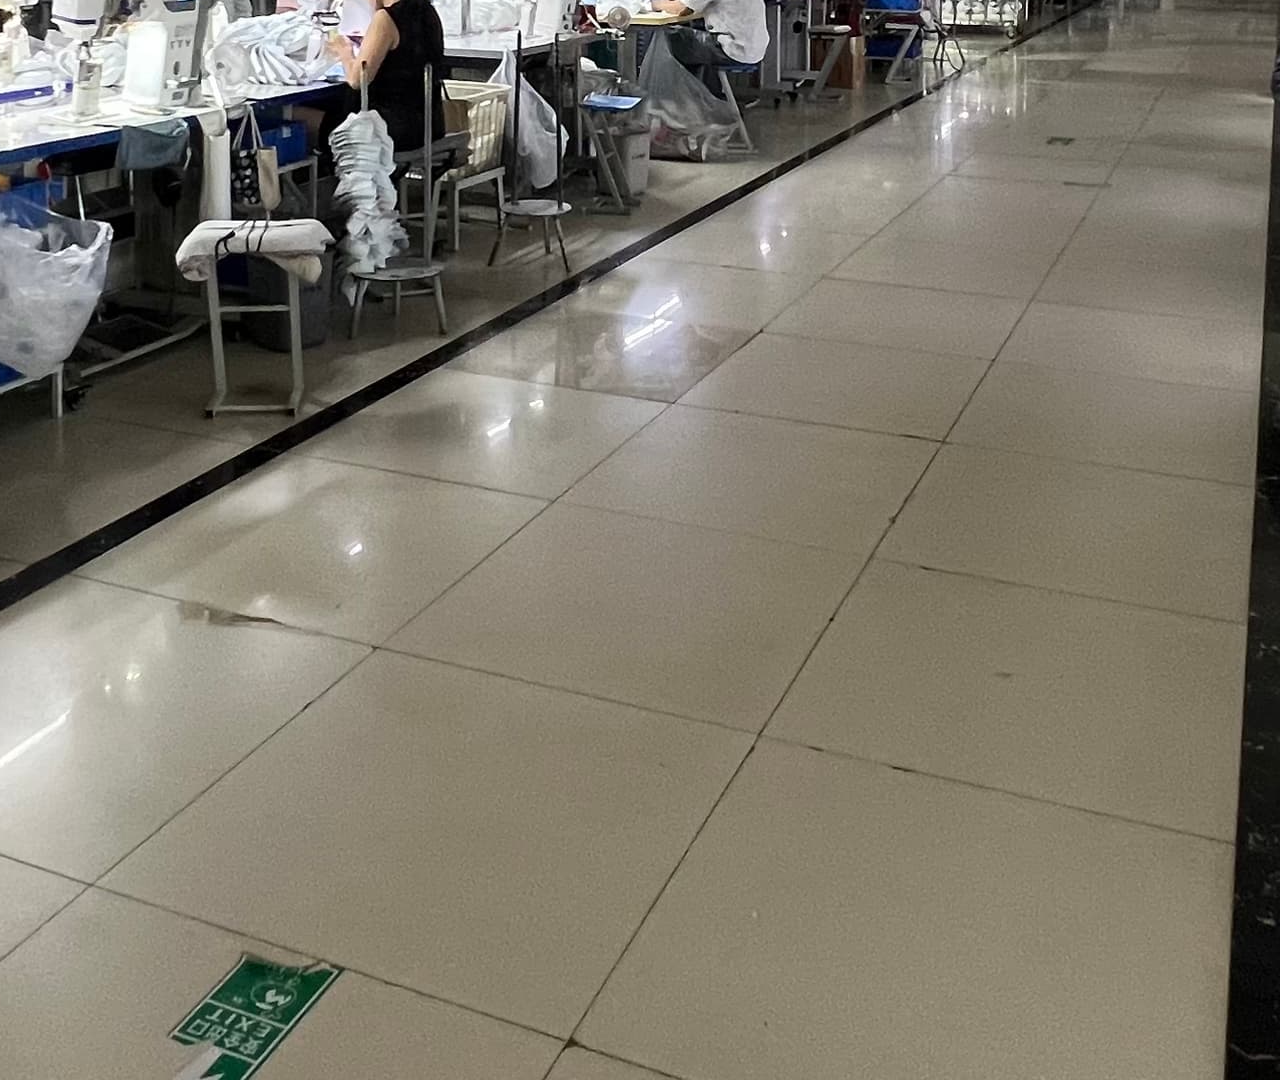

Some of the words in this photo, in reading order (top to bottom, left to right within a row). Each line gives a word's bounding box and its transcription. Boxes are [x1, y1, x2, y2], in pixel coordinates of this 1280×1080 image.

[186, 1018, 265, 1056] 安全出口
[205, 1008, 273, 1038] EXIT
